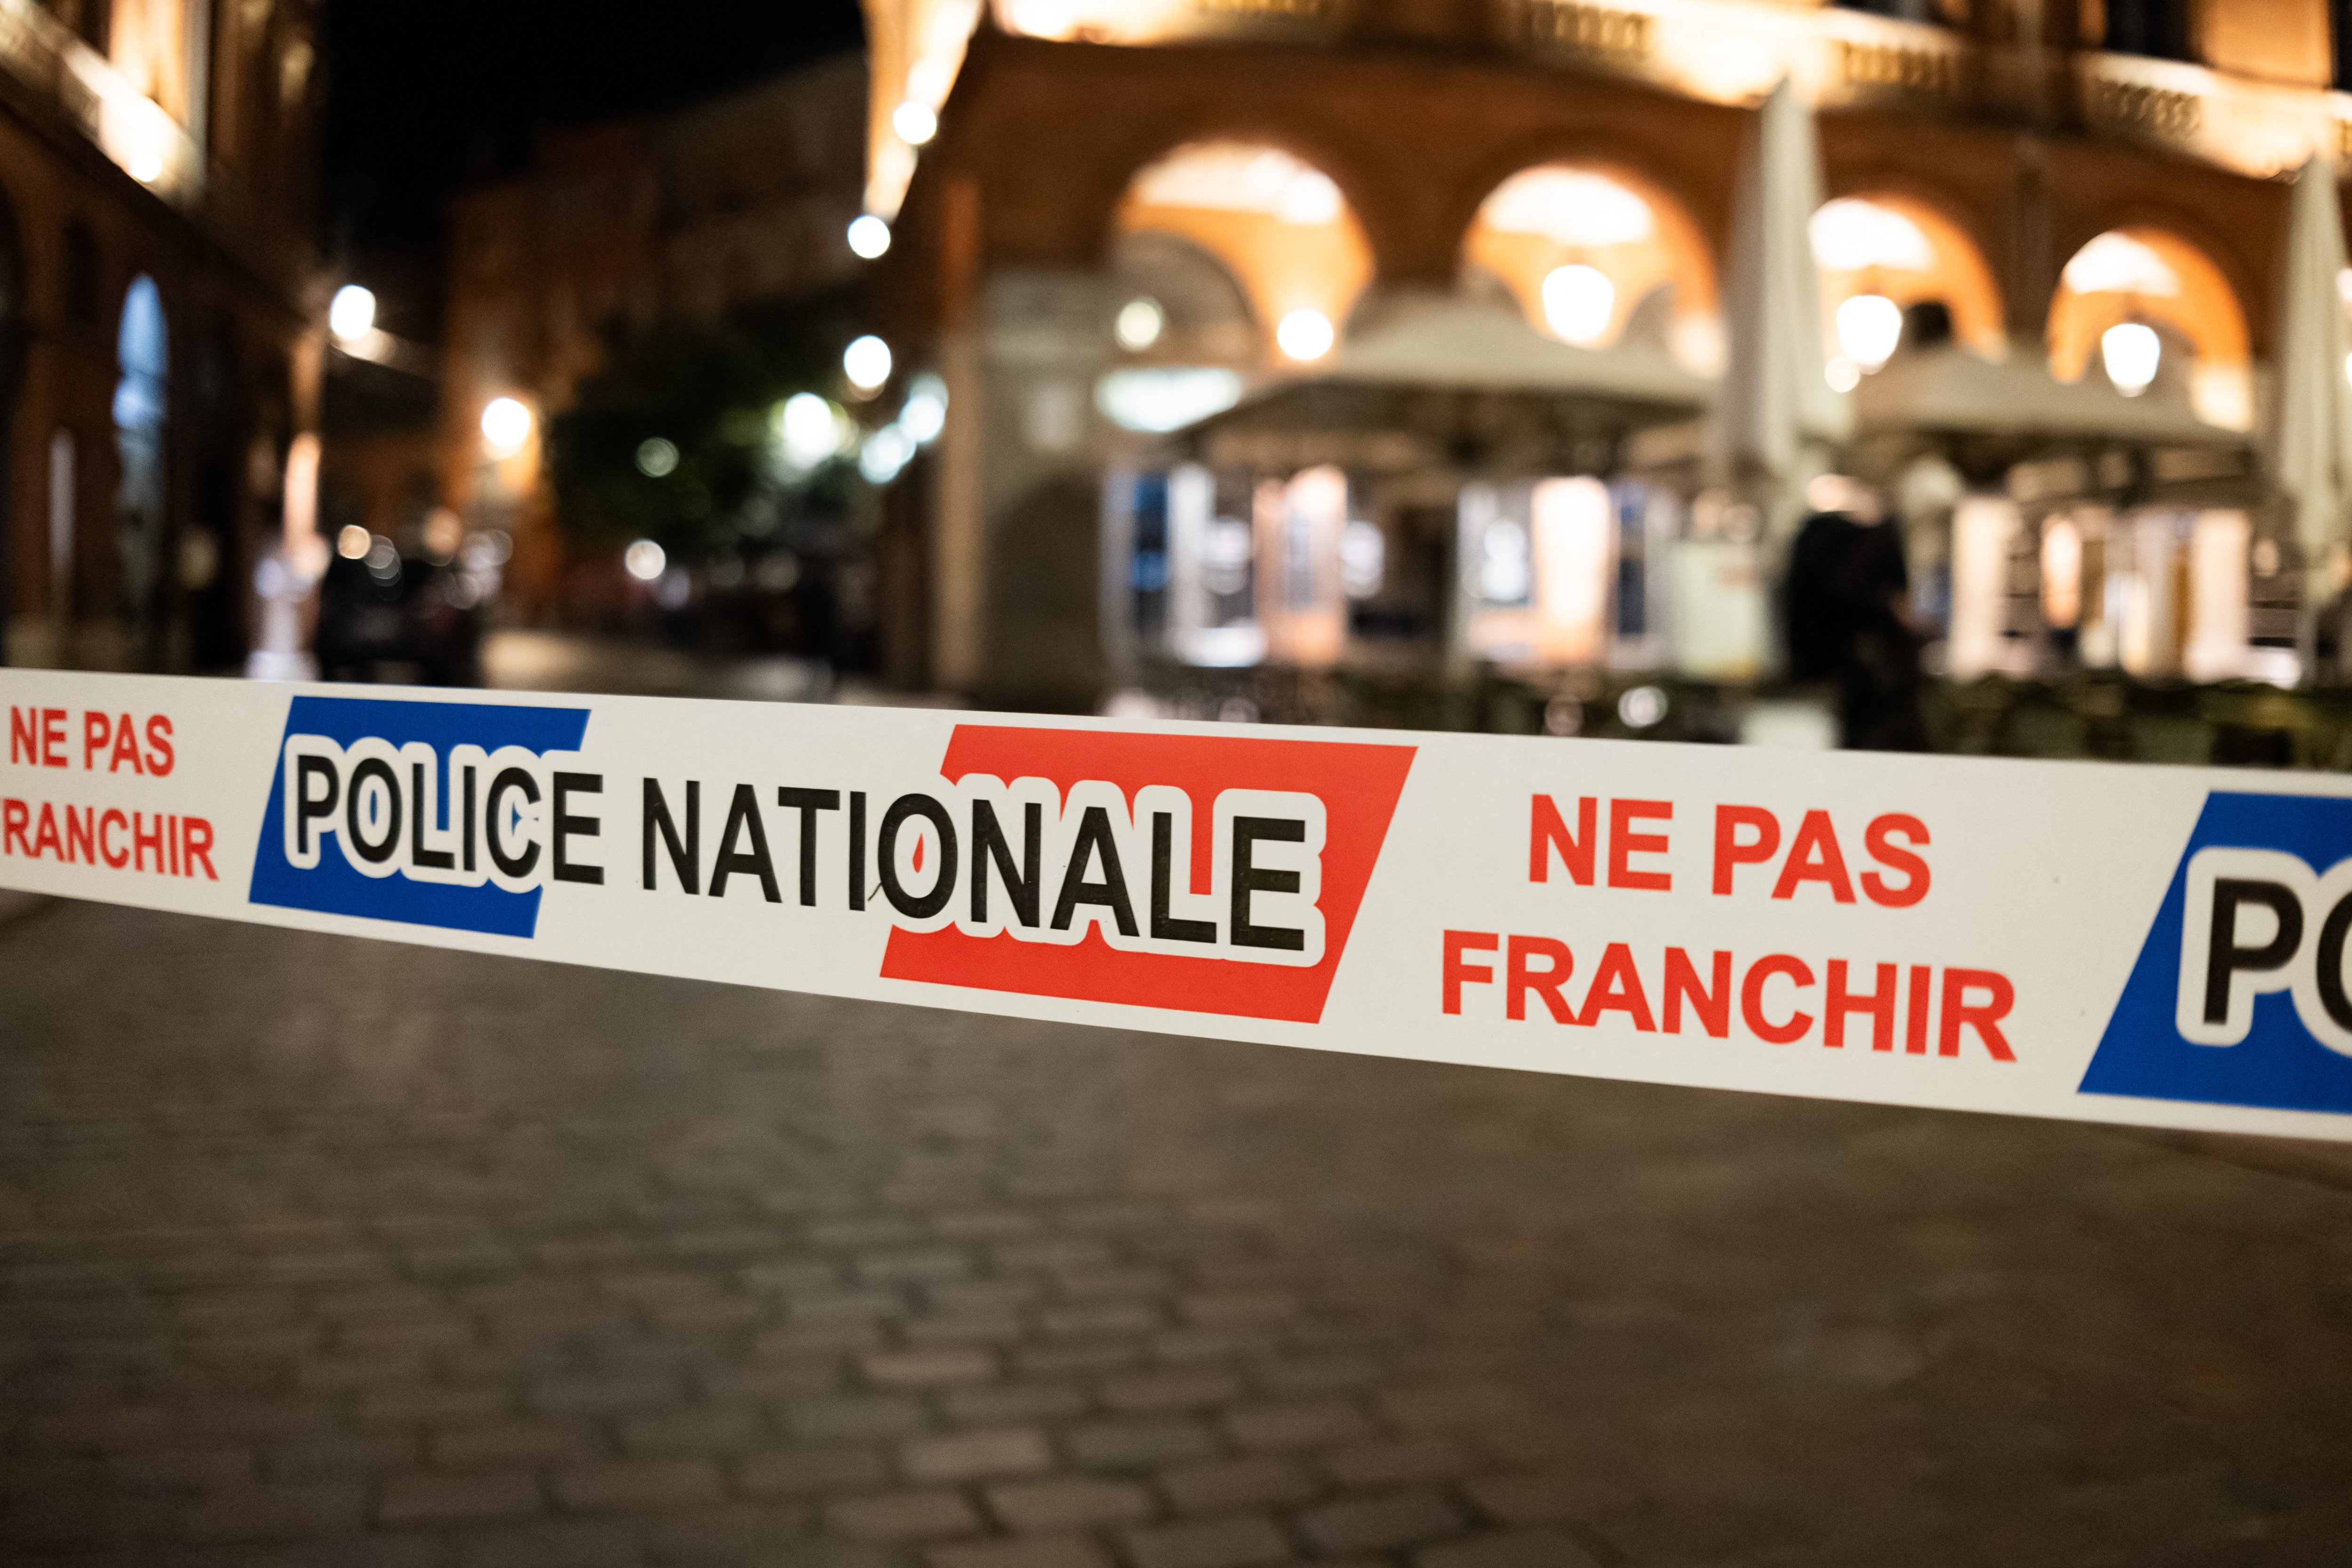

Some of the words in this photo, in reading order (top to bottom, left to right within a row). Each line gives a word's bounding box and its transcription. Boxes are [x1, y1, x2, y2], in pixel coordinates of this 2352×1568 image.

[10, 705, 69, 769] NE
[84, 710, 175, 778] PAS
[297, 754, 604, 885] POLICE
[642, 777, 1305, 952] NATIONALE
[1528, 793, 1674, 892] NE
[1711, 804, 1931, 909] PAS
[1441, 929, 2017, 1062] FRANCHIR
[2203, 877, 2352, 1035] P
